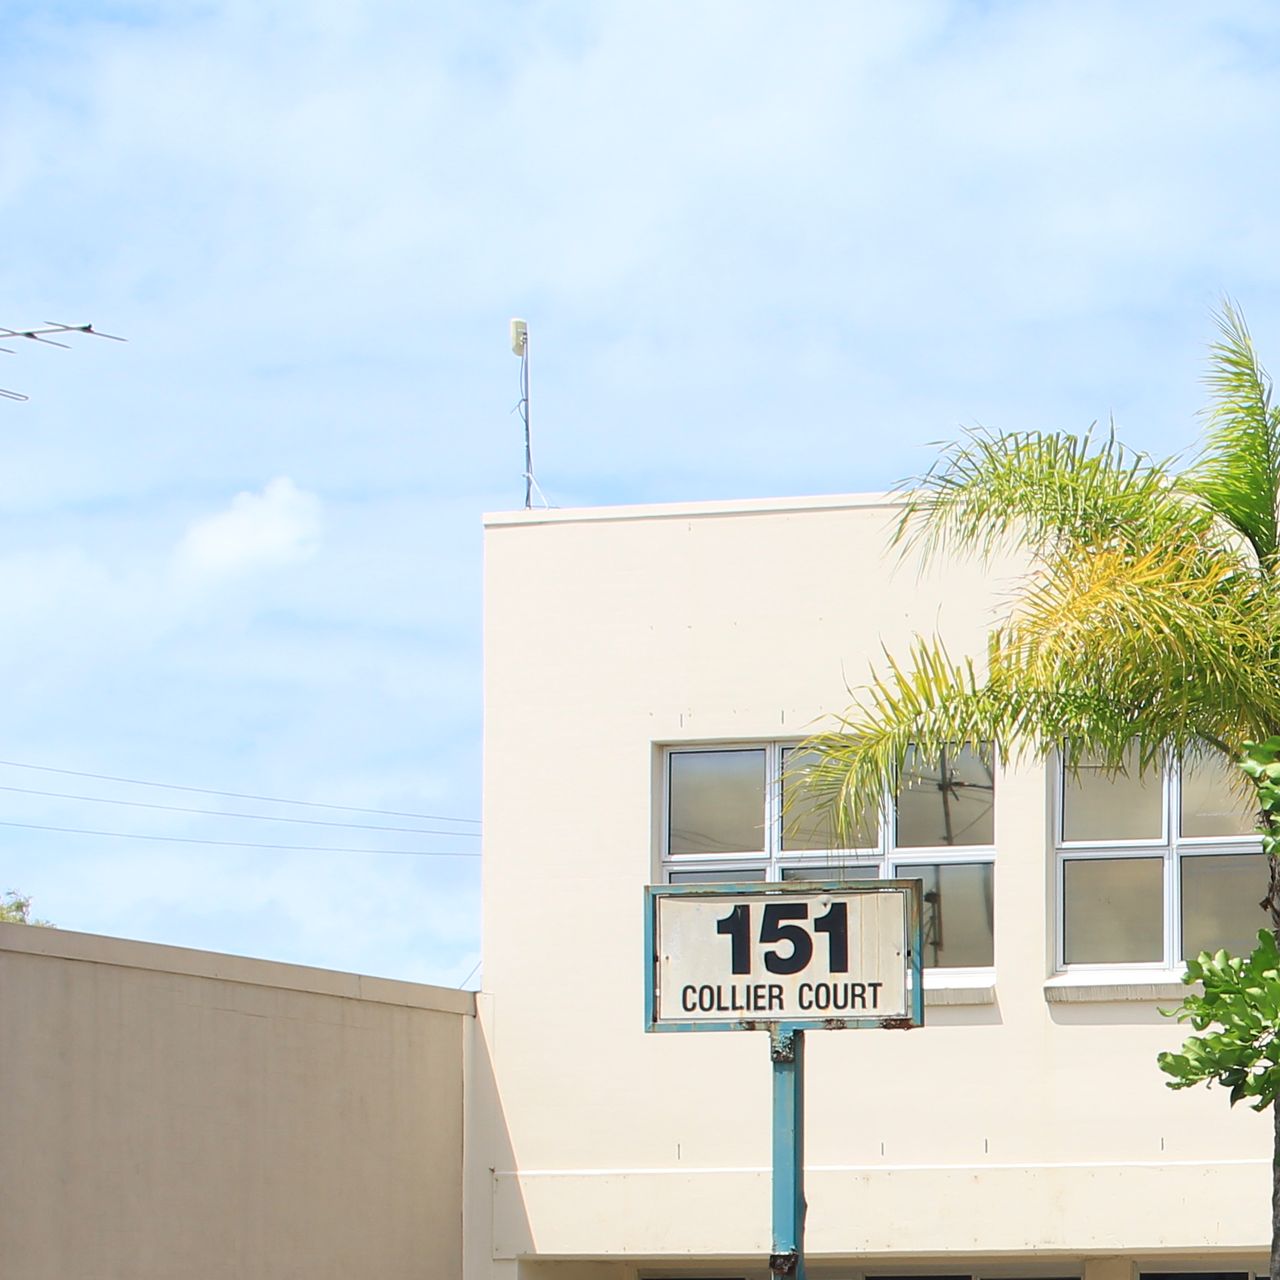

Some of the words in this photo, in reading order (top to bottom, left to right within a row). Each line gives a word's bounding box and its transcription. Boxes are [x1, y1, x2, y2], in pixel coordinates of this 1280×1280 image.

[716, 902, 848, 975] 151
[682, 984, 784, 1012] COLLIER
[799, 982, 882, 1010] COURT
